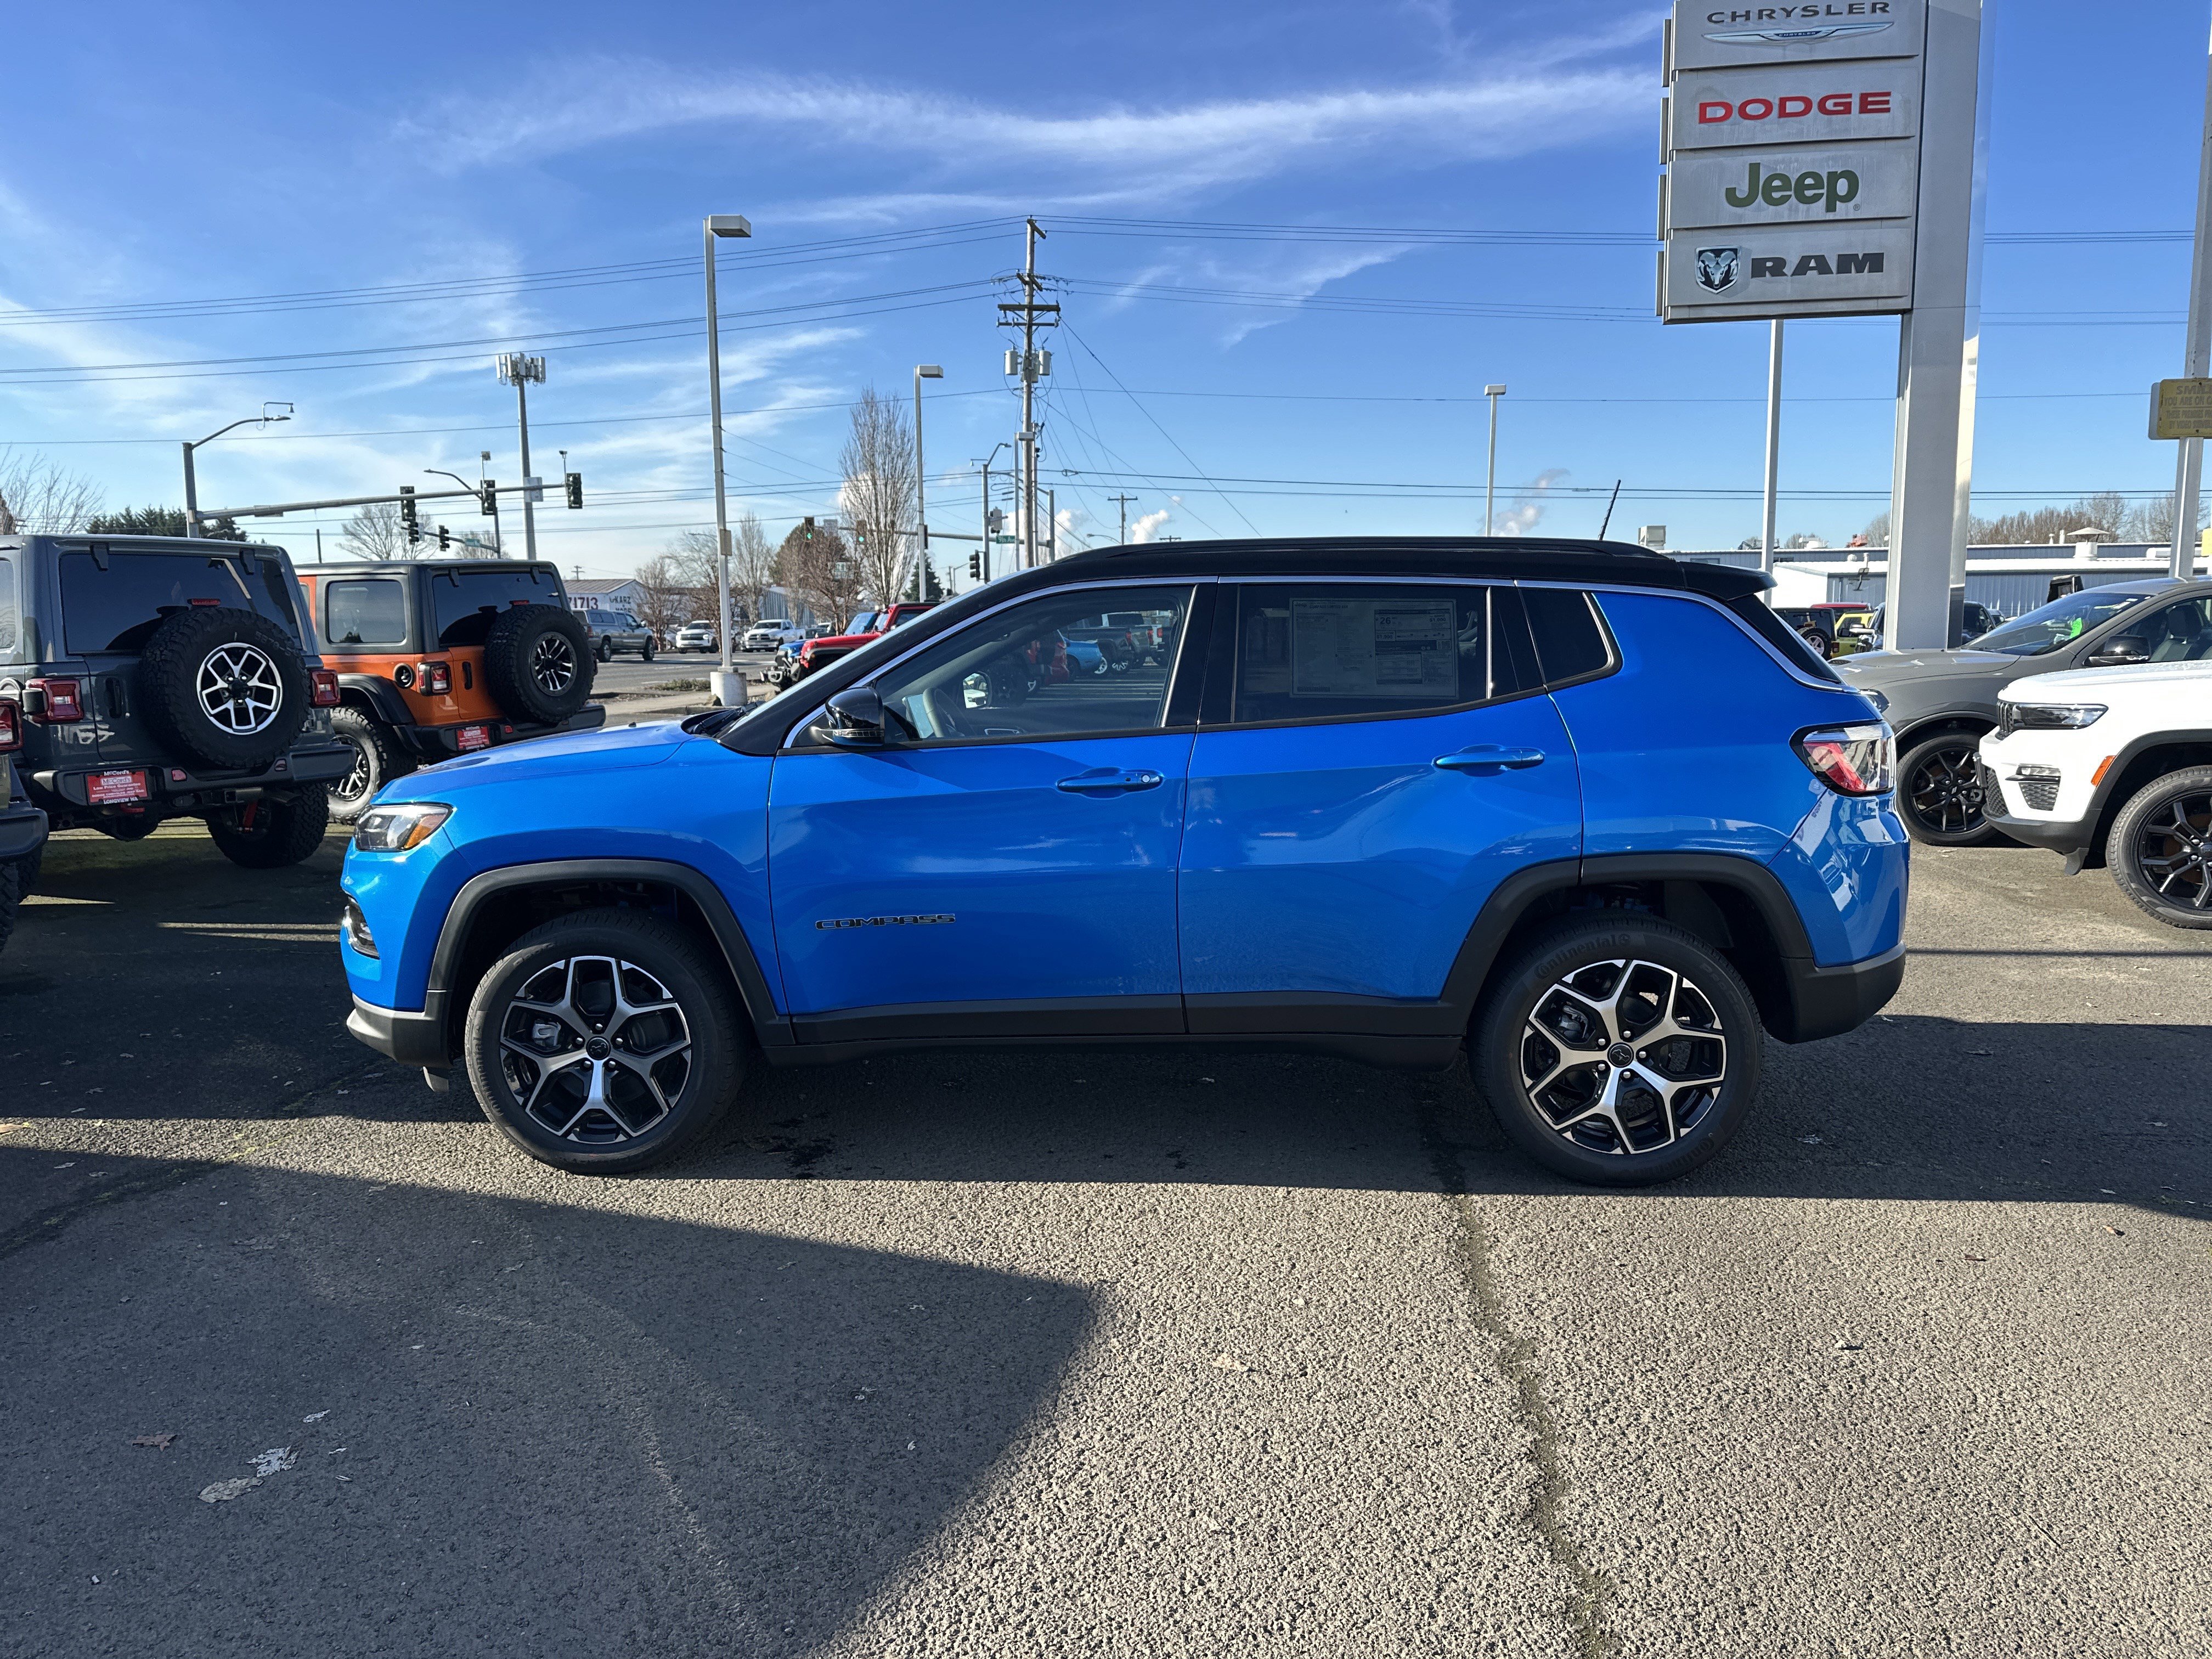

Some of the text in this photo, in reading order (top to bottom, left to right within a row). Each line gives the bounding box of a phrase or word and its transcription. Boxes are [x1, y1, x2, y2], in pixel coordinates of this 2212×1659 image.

[1706, 2, 1890, 24] CHRYSLER
[1699, 91, 1892, 124] DODGE
[1725, 162, 1859, 213] Jeep
[1751, 252, 1884, 279] RAM
[2164, 397, 2177, 406] YOU
[2180, 396, 2193, 405] ARE
[815, 913, 956, 930] COMPASS
[1534, 934, 1616, 980] Continental
